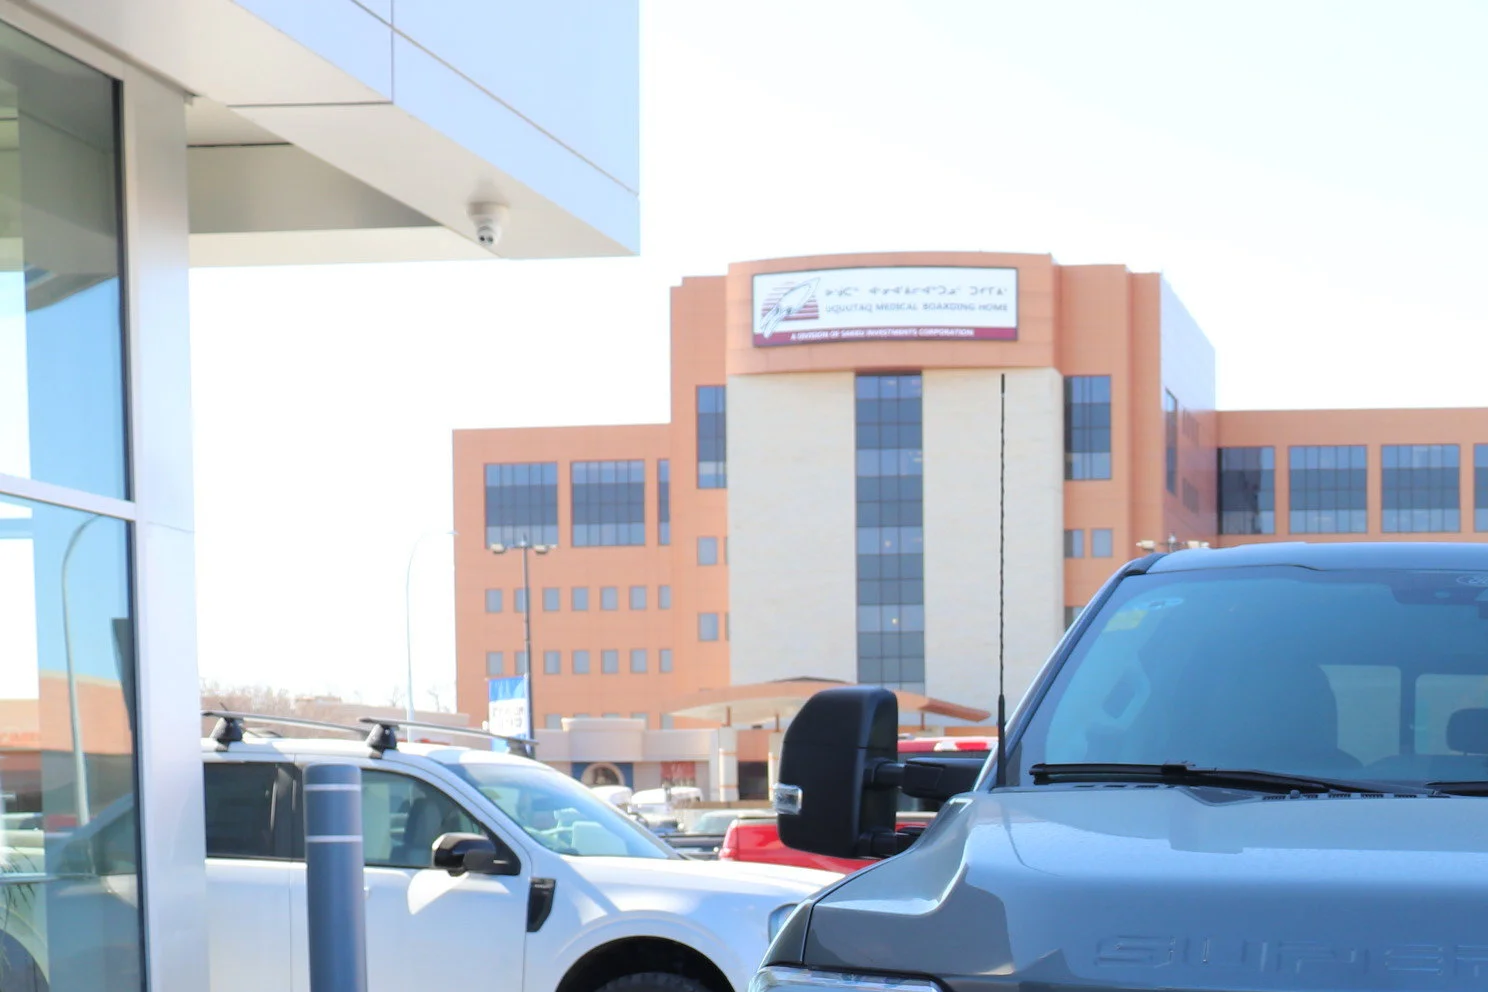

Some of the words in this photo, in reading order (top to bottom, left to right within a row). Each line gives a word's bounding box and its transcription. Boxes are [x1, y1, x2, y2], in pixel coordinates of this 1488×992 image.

[876, 303, 917, 312] MEDICAL
[923, 303, 975, 312] BOARDING
[978, 303, 1008, 312] HOME
